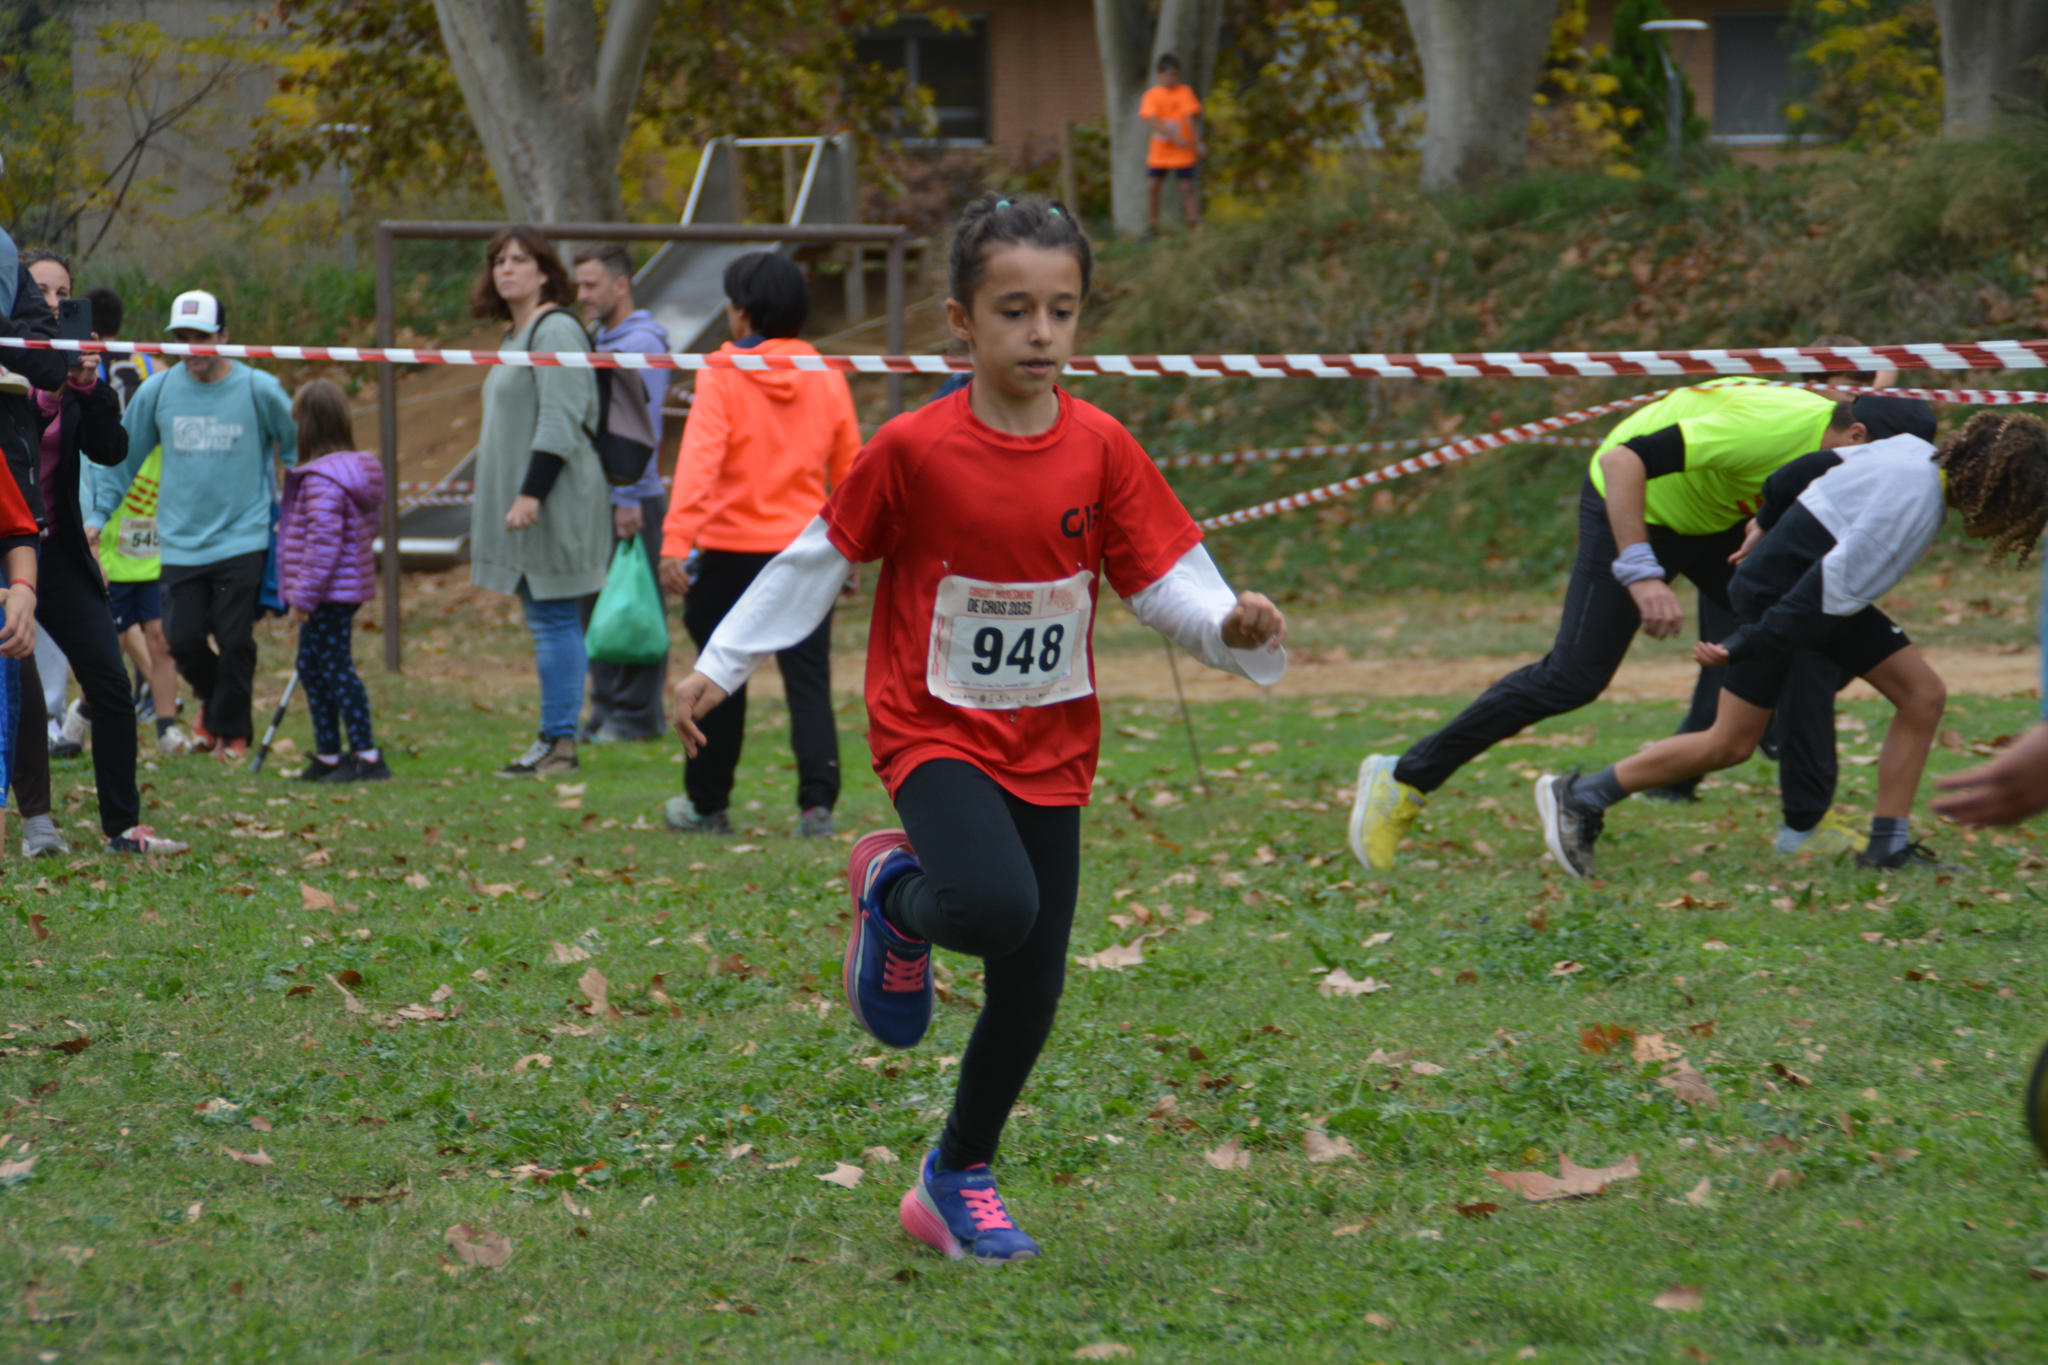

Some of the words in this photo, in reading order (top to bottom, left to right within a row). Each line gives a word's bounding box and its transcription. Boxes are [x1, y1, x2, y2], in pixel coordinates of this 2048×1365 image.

[967, 597, 979, 614] DE
[1008, 600, 1032, 616] 2025
[971, 623, 1065, 676] 948
